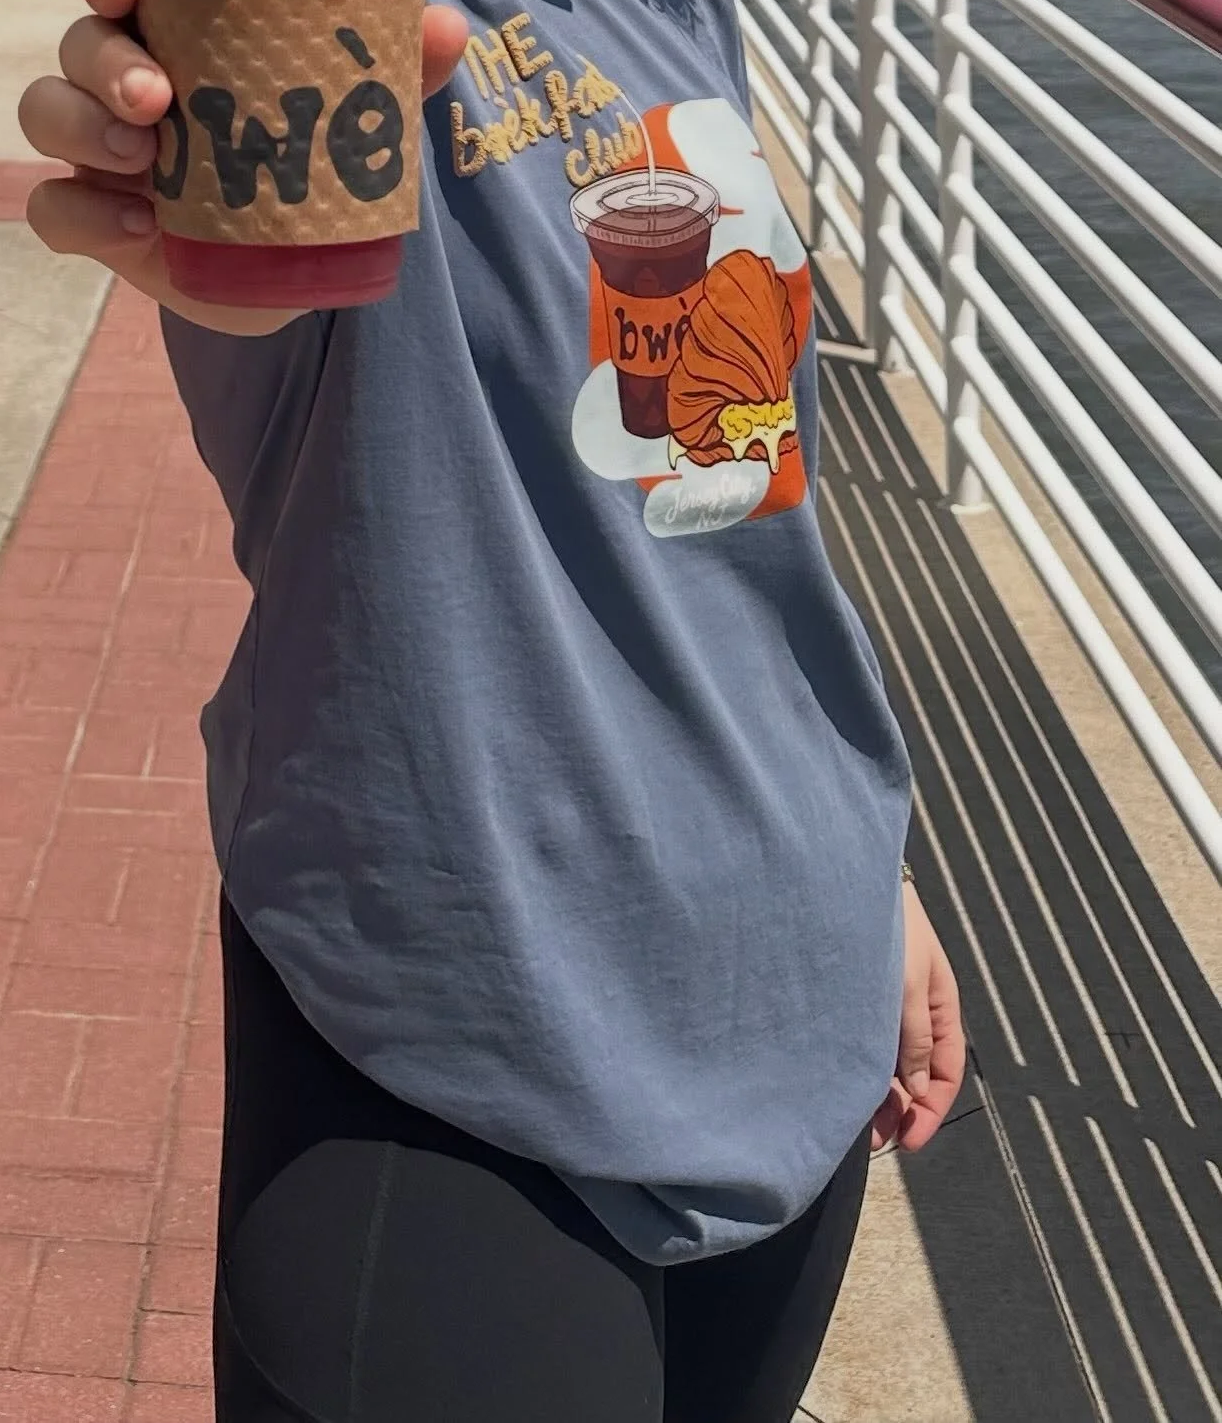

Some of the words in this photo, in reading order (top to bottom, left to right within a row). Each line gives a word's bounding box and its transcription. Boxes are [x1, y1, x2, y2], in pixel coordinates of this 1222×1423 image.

[464, 12, 554, 100] THE
[565, 111, 644, 188] club
[696, 502, 729, 531] NJ
